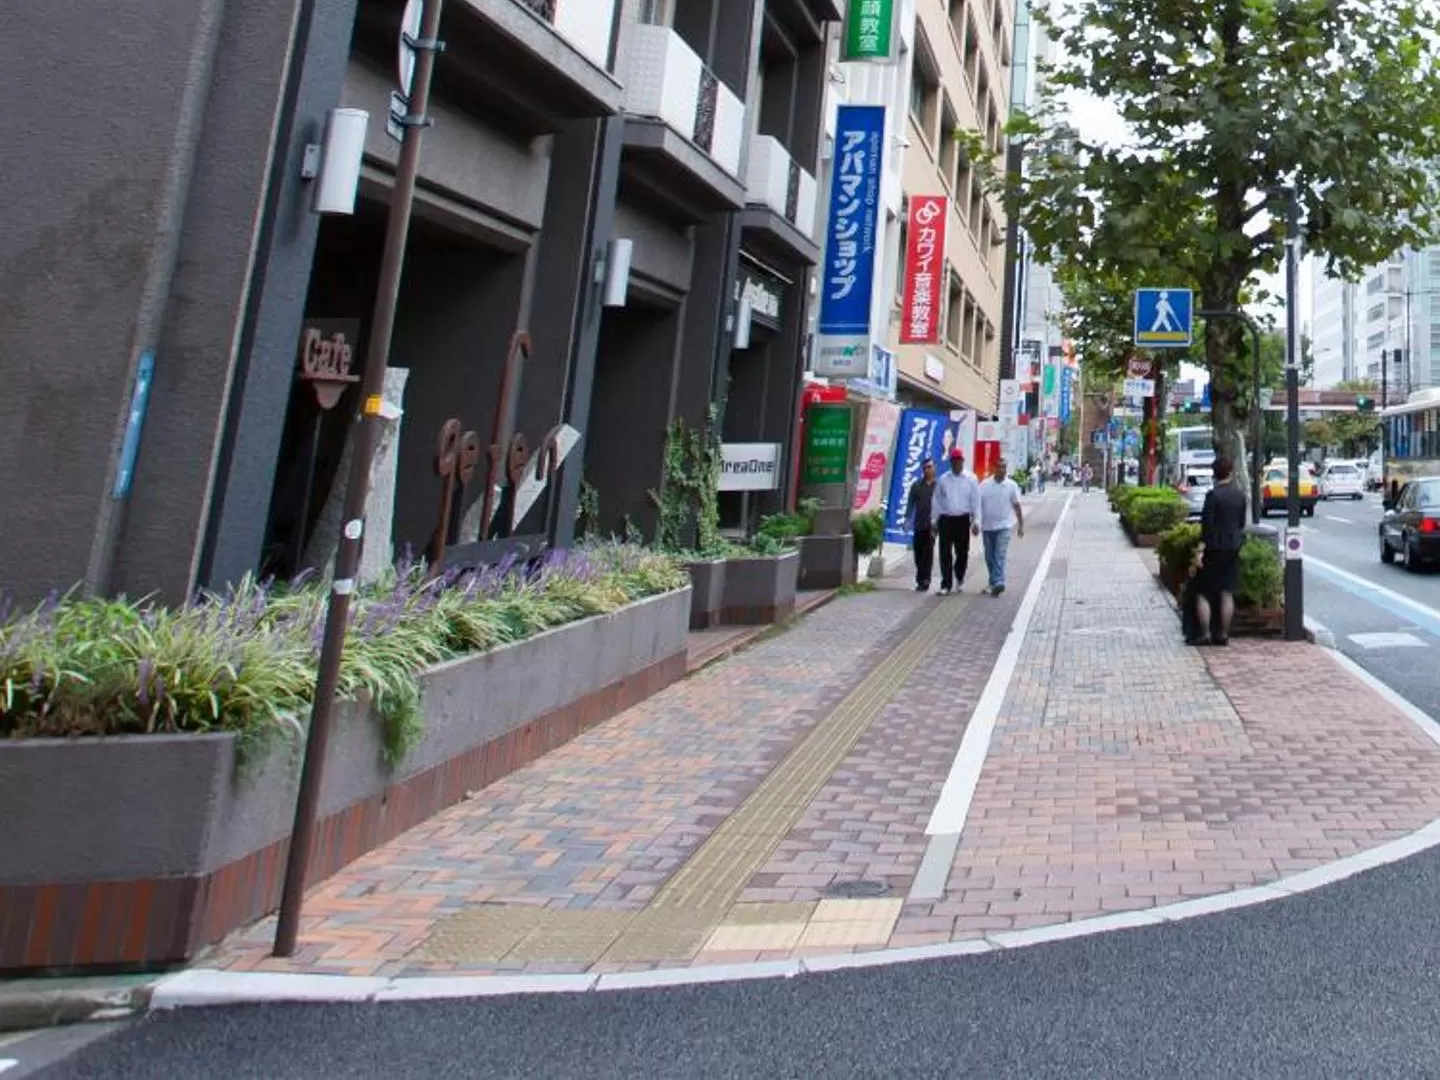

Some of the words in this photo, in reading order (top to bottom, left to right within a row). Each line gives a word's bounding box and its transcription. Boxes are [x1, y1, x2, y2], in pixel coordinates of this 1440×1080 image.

[831, 130, 866, 300] アパマンショップ
[909, 227, 937, 338] カワイ音楽教室
